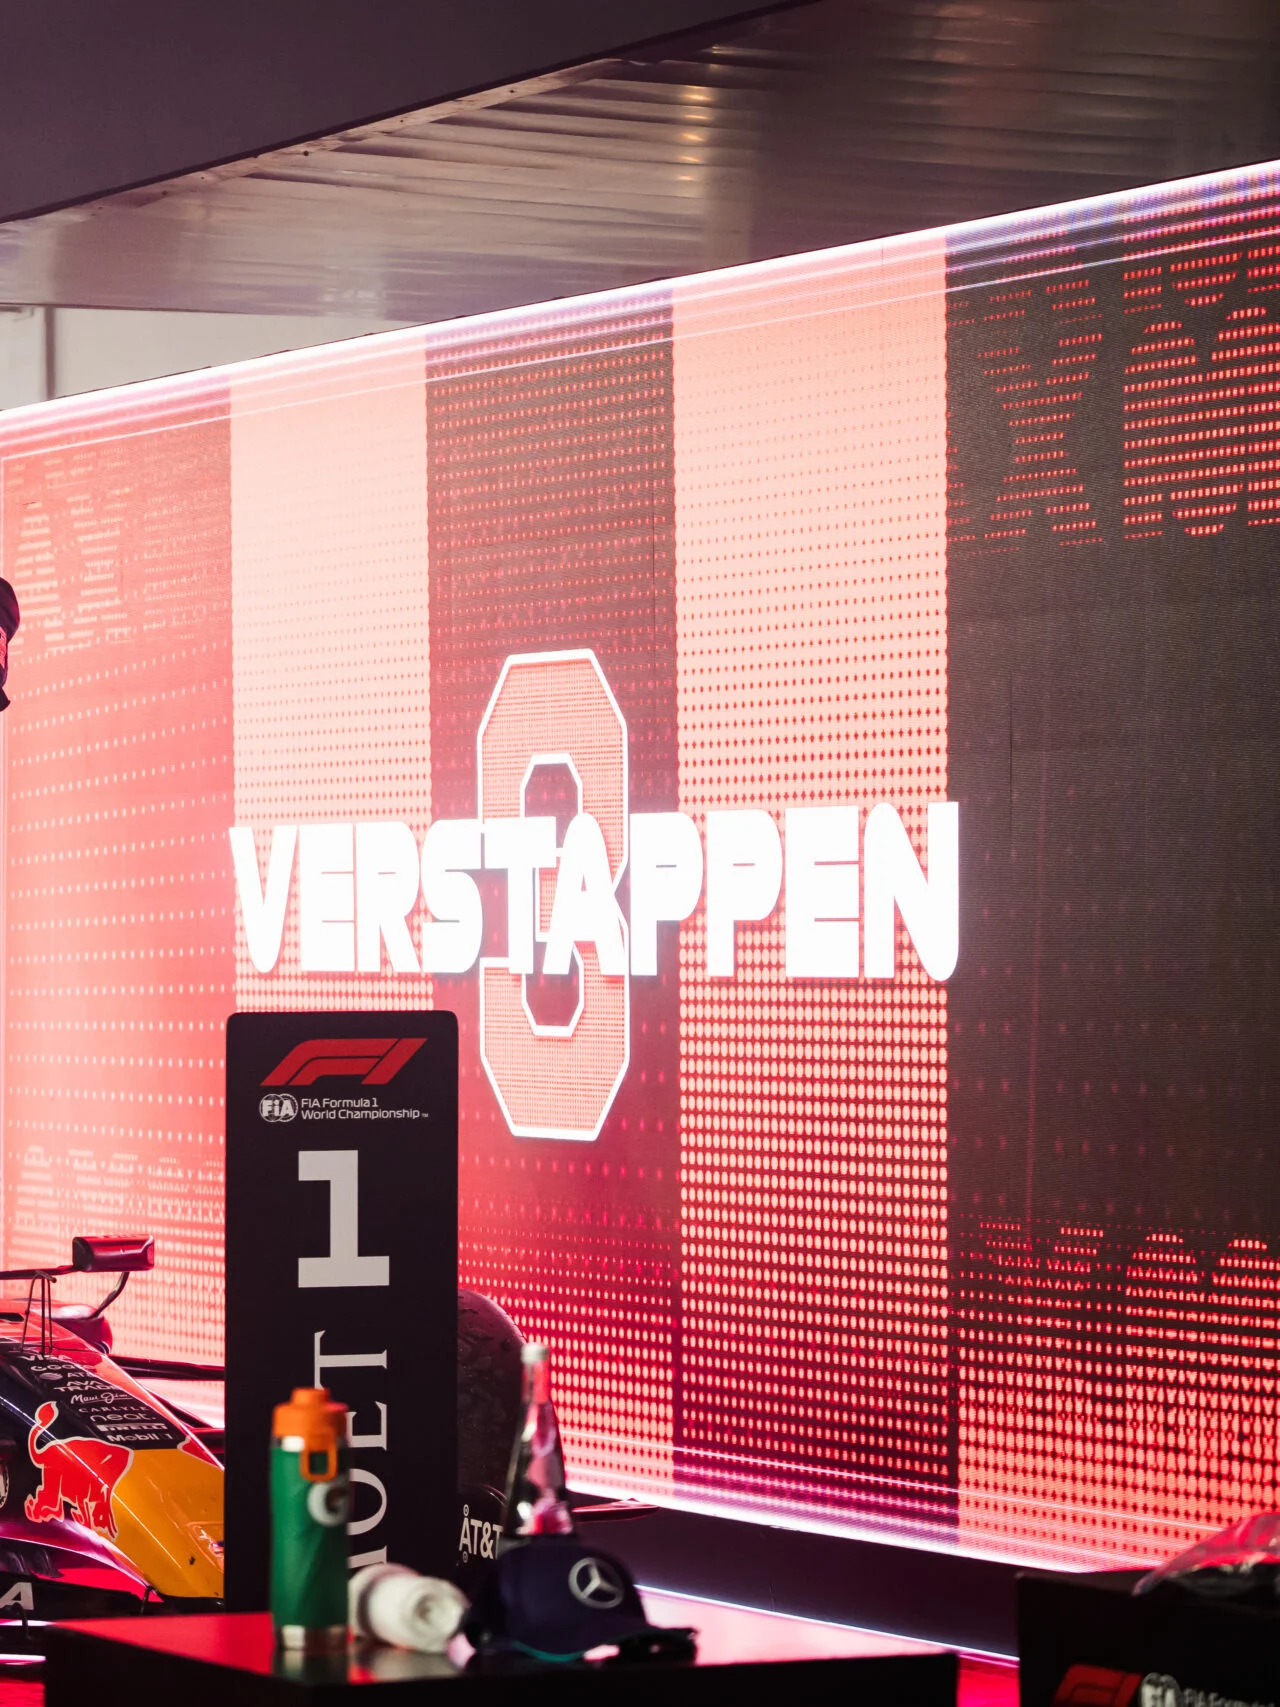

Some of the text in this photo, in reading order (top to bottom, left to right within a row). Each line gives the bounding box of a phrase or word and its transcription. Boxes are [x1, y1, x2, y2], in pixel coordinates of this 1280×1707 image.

[228, 801, 960, 982] VERSTAPPEN
[302, 1099, 320, 1108] FIA
[323, 1098, 370, 1108] Formula
[372, 1098, 379, 1107] 1
[302, 1110, 336, 1120] World
[338, 1109, 420, 1120] Championship
[298, 1149, 390, 1287] 1
[78, 1405, 149, 1413] CARLYLE
[96, 1422, 169, 1433] PIRELLI
[107, 1432, 160, 1443] Mobil
[458, 1514, 503, 1561] AT&T
